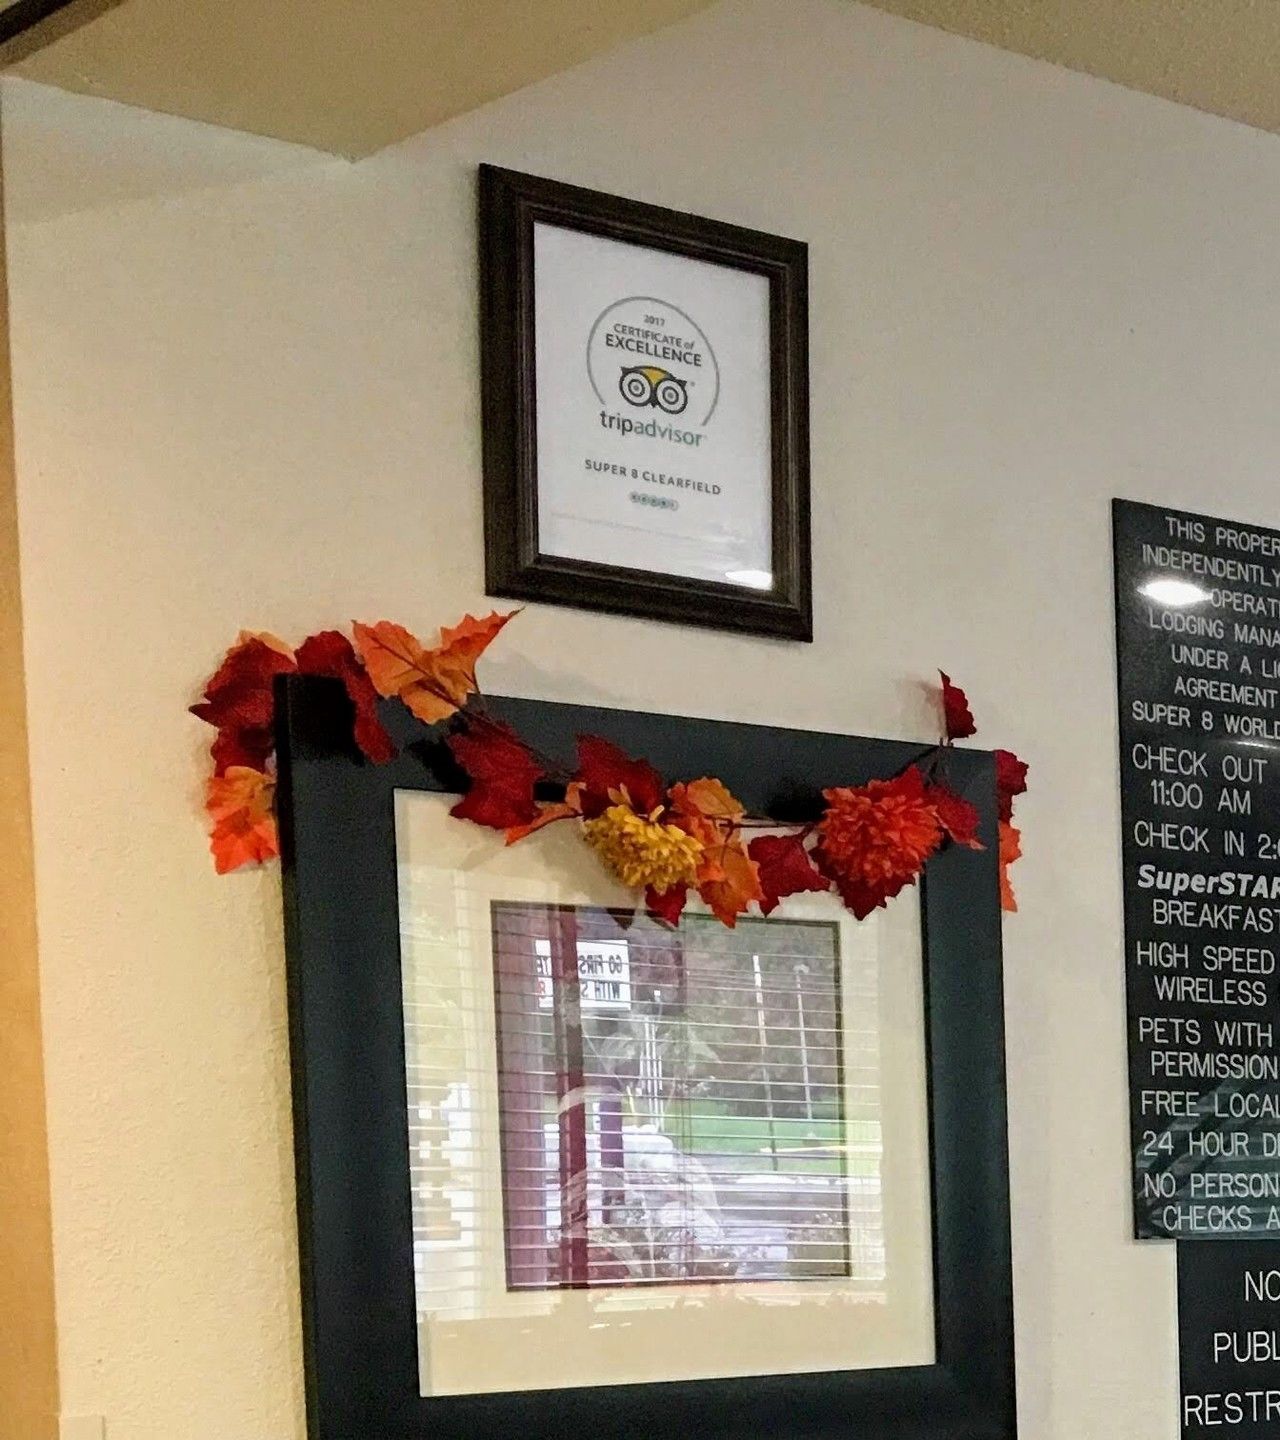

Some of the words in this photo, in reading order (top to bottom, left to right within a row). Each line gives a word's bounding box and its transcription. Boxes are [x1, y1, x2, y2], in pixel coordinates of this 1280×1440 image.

[644, 314, 665, 327] 2017
[605, 333, 702, 368] EXCELLENCE
[614, 323, 683, 348] CERTIFICATE
[683, 340, 695, 351] of
[599, 409, 705, 448] tripadvisor
[584, 459, 628, 478] SUPER
[631, 468, 639, 479] 8
[642, 470, 721, 496] CLEARFIELD
[1166, 516, 1205, 543] THIS
[1149, 611, 1224, 639] LODGING
[1172, 644, 1228, 670] UNDER
[1240, 656, 1252, 674] A
[1174, 676, 1278, 708] AGREEMENT
[1132, 700, 1190, 727] SUPER
[1202, 710, 1213, 730] 8
[1132, 744, 1208, 778] CHECK
[1222, 755, 1268, 784] OUT
[1150, 780, 1203, 809] 11:00
[1218, 788, 1251, 815] AM
[1134, 820, 1210, 853] CHECK
[1224, 830, 1244, 856] IN
[1136, 941, 1189, 969] HIGH
[1203, 945, 1276, 974] SPEED
[1154, 974, 1267, 1006] WIRELESS
[1139, 1017, 1201, 1045] PETS
[1215, 1020, 1273, 1048] WITH
[1151, 1050, 1278, 1080] PERMISSION
[1141, 1090, 1200, 1117] FREE
[1142, 1130, 1174, 1156] 24
[1189, 1132, 1249, 1156] HOUR
[1144, 1172, 1176, 1198] NO
[1162, 1205, 1252, 1230] CHECKS
